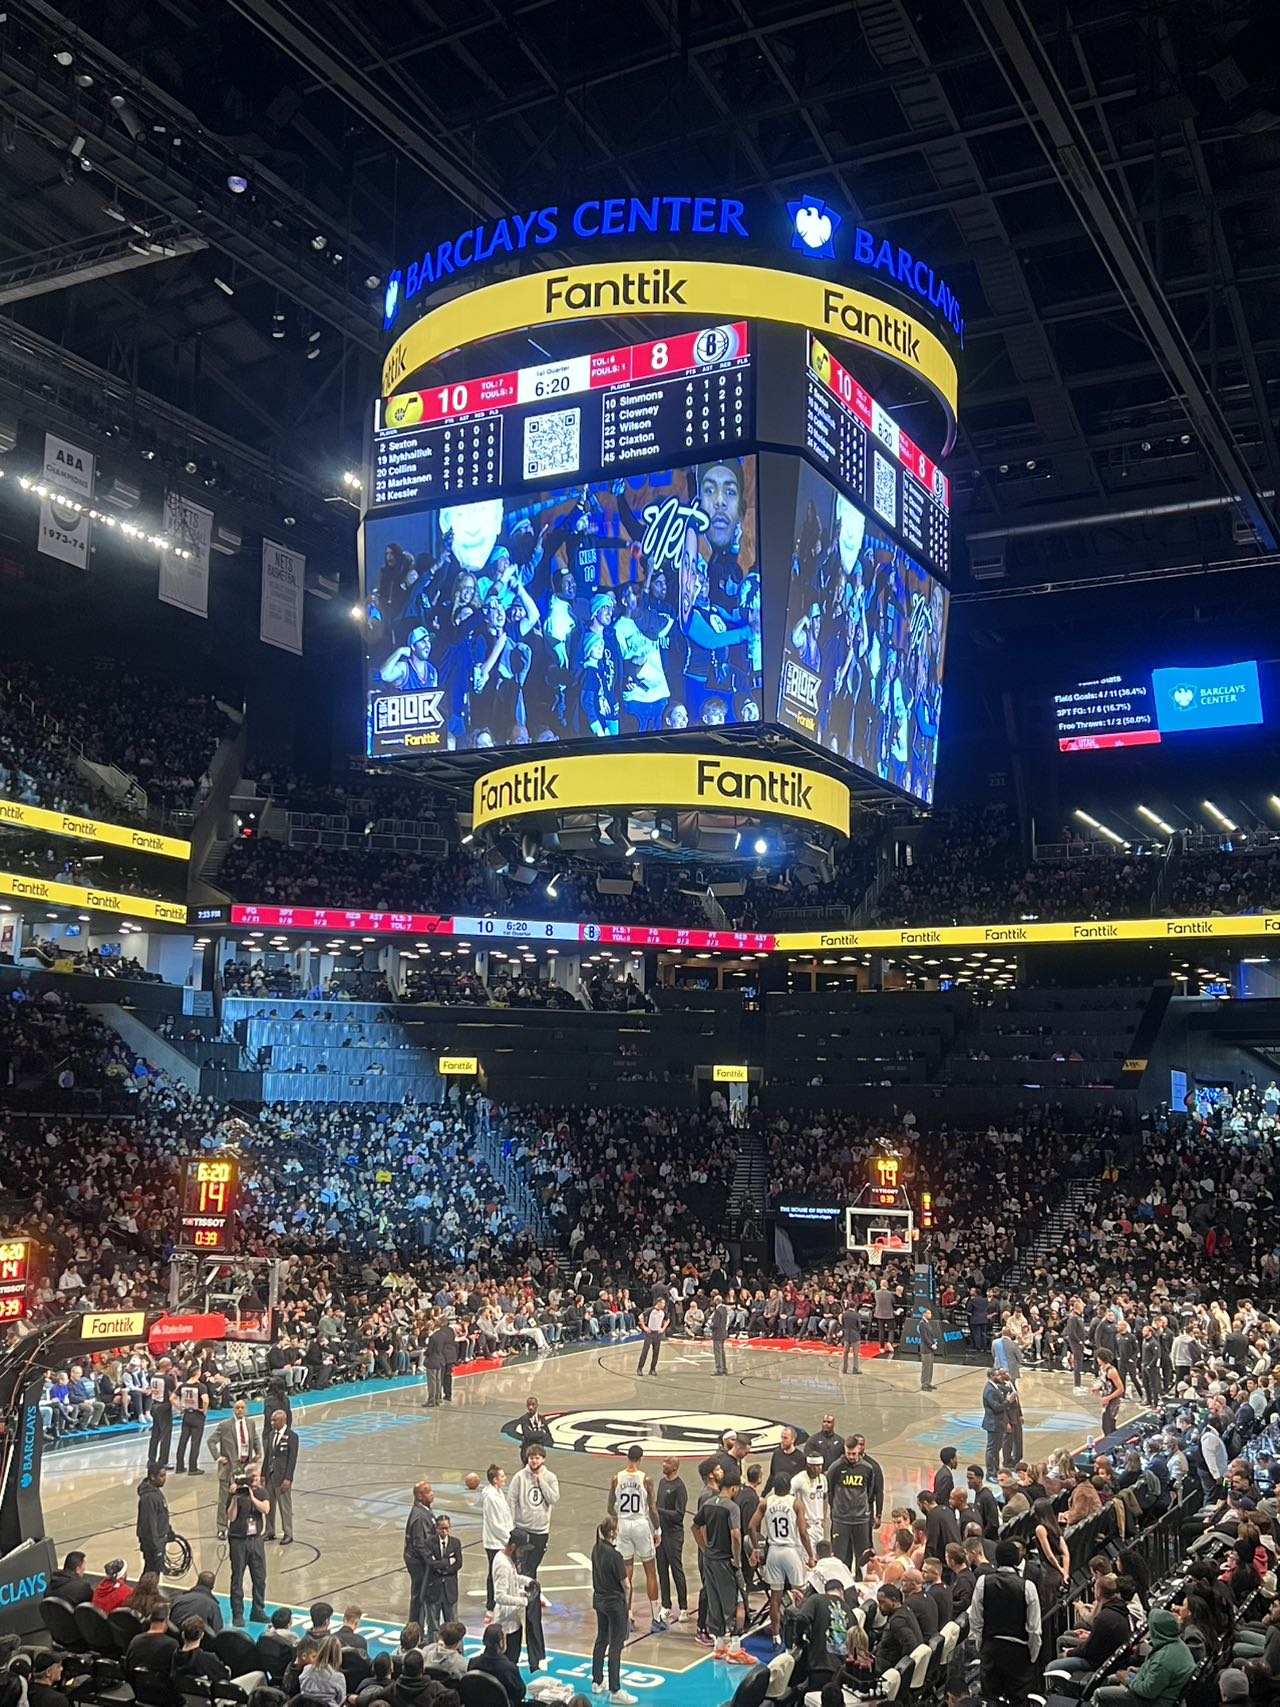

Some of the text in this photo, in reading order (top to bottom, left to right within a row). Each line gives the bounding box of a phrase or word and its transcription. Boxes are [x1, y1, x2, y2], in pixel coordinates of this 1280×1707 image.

[406, 196, 750, 300] BARCLAYS CENTER
[854, 227, 961, 334] BARCLAYS
[546, 269, 688, 314] Fanttik
[824, 288, 920, 364] Fanttik
[652, 342, 668, 370] 8
[546, 366, 570, 375] Quarter
[592, 365, 620, 376] FOULS:
[481, 389, 508, 399] FOULS:
[535, 376, 570, 396] 6:20
[606, 372, 742, 410] 10 Simmons 4 1 0 1
[837, 368, 852, 402] 10
[438, 385, 468, 414] 10
[605, 386, 742, 422] 21 Clowney 0 1 2 0
[605, 400, 742, 436] 22 Wilson 0 0 1 0
[380, 422, 494, 452] 2 Sexton 0 1 0 1
[604, 414, 742, 449] 33 Claxton 4 0 1 0
[878, 422, 892, 448] 6:20
[378, 456, 388, 465] 19
[444, 443, 450, 453] 5
[458, 441, 464, 450] 0
[473, 438, 479, 448] 0
[488, 435, 494, 444] 0
[604, 427, 741, 462] 45 Johnson 0 1 1 1
[56, 449, 83, 472] ABA
[377, 448, 494, 477] 20 Collins 2 0 0 0
[919, 454, 926, 478] 8
[376, 461, 493, 490] 23 Markkanen 2 0 3 0
[376, 473, 493, 502] 24 Kessler 1 2 2 2
[43, 526, 85, 551] 1973-74
[275, 552, 294, 572] NETS
[584, 565, 596, 582] 10
[790, 666, 818, 709] BLOCK
[1055, 695, 1073, 703] Field
[1073, 692, 1098, 701] Goals:
[1200, 684, 1246, 696] BARCLAYS
[1073, 707, 1086, 715] FG:
[1103, 703, 1131, 714] (16.7%)
[1201, 694, 1237, 704] CENTER
[388, 694, 442, 726] BLOCK
[1058, 722, 1075, 730] Free
[1076, 720, 1106, 729] Throws:
[405, 732, 440, 746] Fanttik
[480, 766, 560, 815] Fanttik
[696, 760, 813, 810] Fanttik
[62, 817, 97, 836] Fanttik
[132, 833, 165, 850] Fanttik
[12, 879, 49, 898] Fanttik
[87, 892, 120, 910] Fanttik
[155, 905, 187, 921] Fanttik
[478, 920, 494, 933] 10
[506, 922, 527, 931] 6:20
[546, 924, 553, 936] 8
[900, 930, 940, 943] Fanttik
[984, 928, 1027, 941] Fanttik
[1074, 924, 1118, 938] Fanttik
[1167, 920, 1213, 934] Fanttik
[820, 934, 859, 947] Fanttik
[443, 1061, 473, 1071] Fanttik
[717, 1069, 744, 1079] Fanttik
[197, 1162, 230, 1182] 6:20
[881, 1170, 896, 1186] 14
[200, 1182, 224, 1212] 14
[193, 1218, 226, 1227] TISSOT
[195, 1231, 218, 1245] 0:39
[2, 1261, 18, 1279] 14
[92, 1318, 134, 1334] Fanttik
[23, 1405, 37, 1470] BARCLAYS
[843, 1475, 864, 1486] JAZZ
[620, 1493, 640, 1513] 20
[772, 1517, 788, 1538] 13
